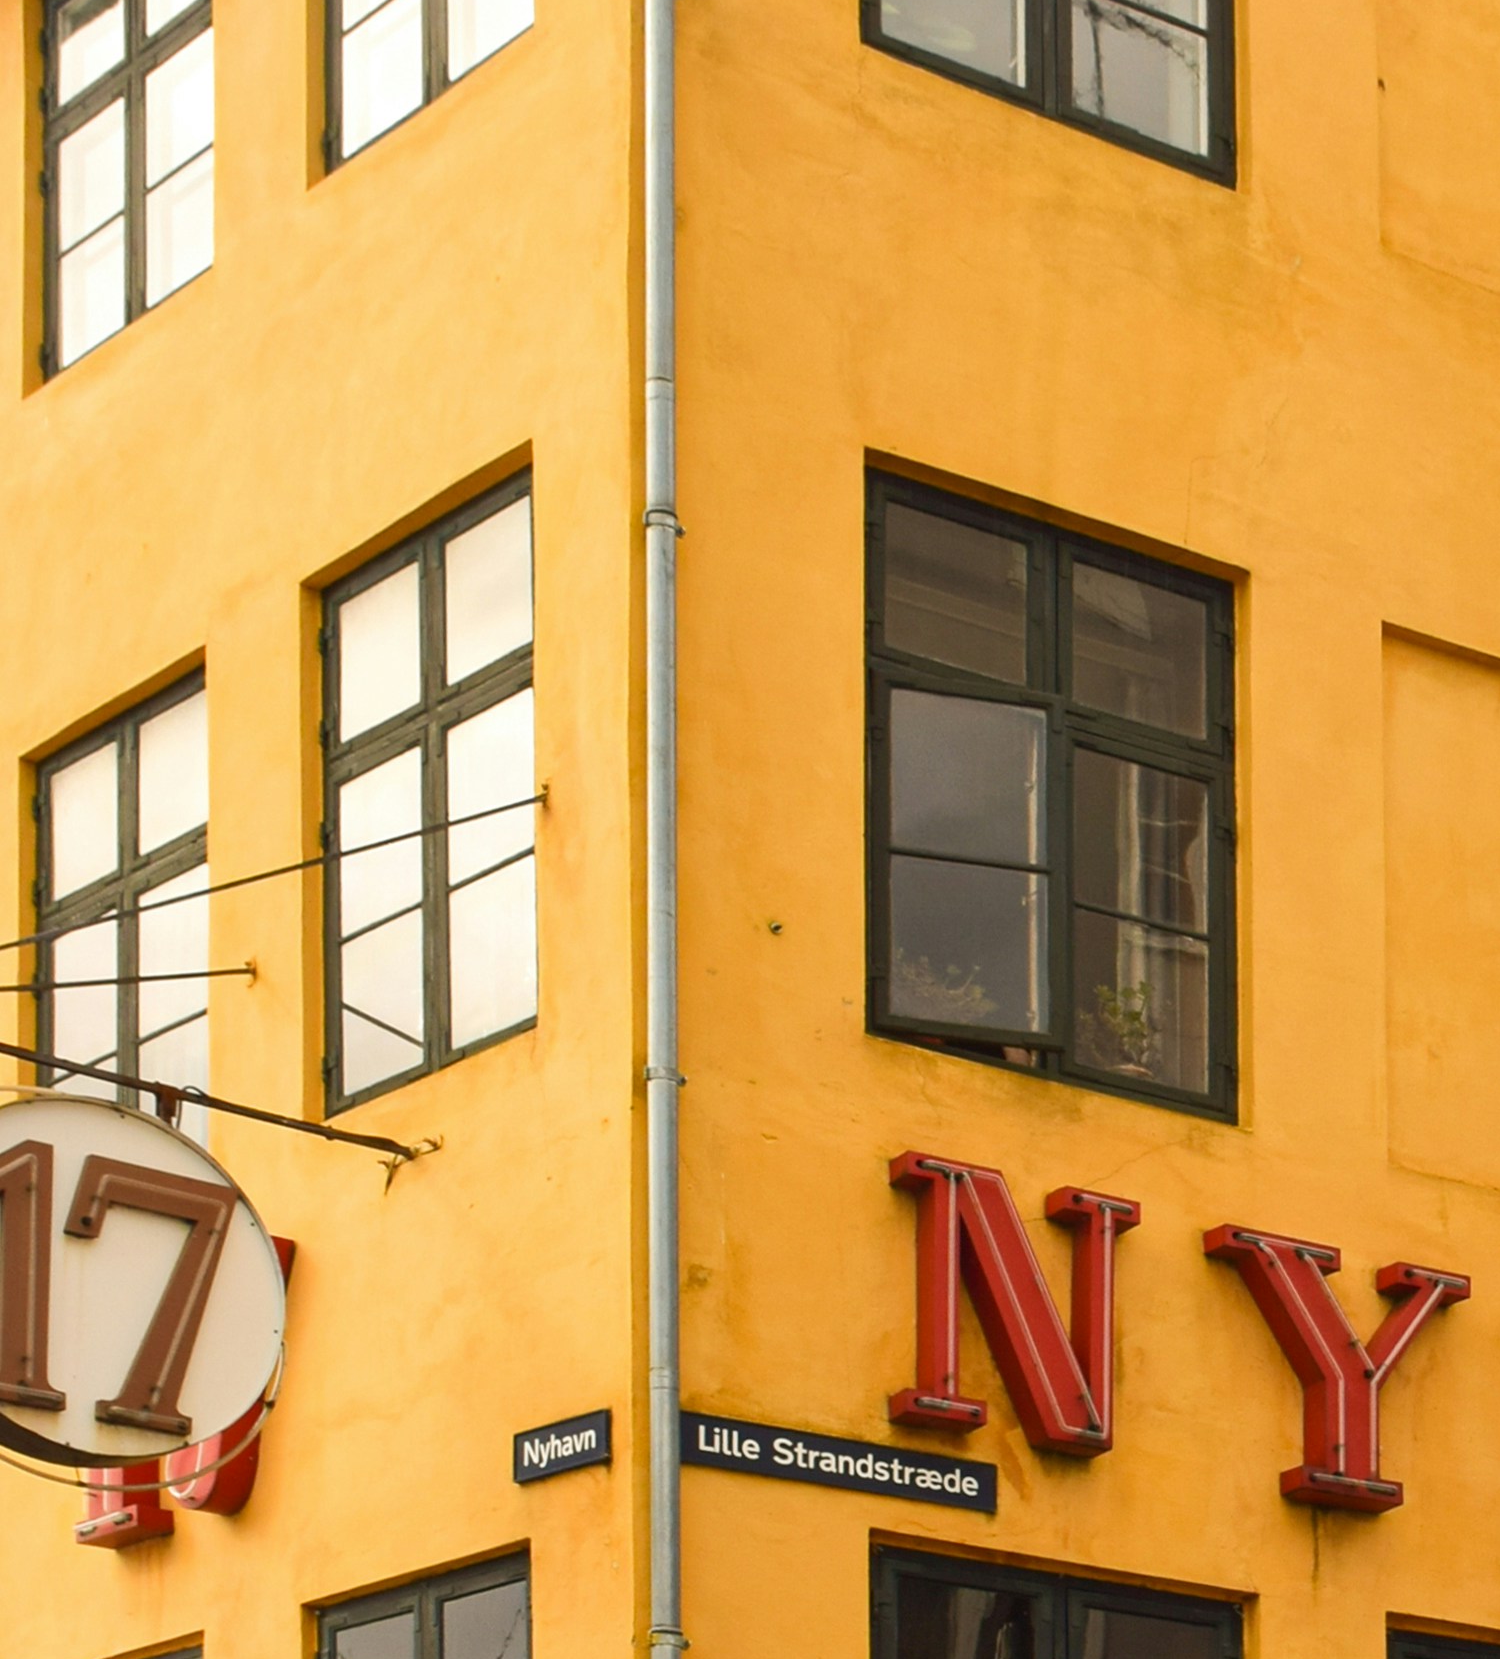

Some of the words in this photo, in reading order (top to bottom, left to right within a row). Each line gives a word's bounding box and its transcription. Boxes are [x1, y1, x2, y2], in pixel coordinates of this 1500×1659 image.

[0, 1138, 240, 1436] 17
[523, 1428, 597, 1469] Nyhavn
[698, 1424, 761, 1461] Lille
[772, 1437, 980, 1497] Strandstræde
